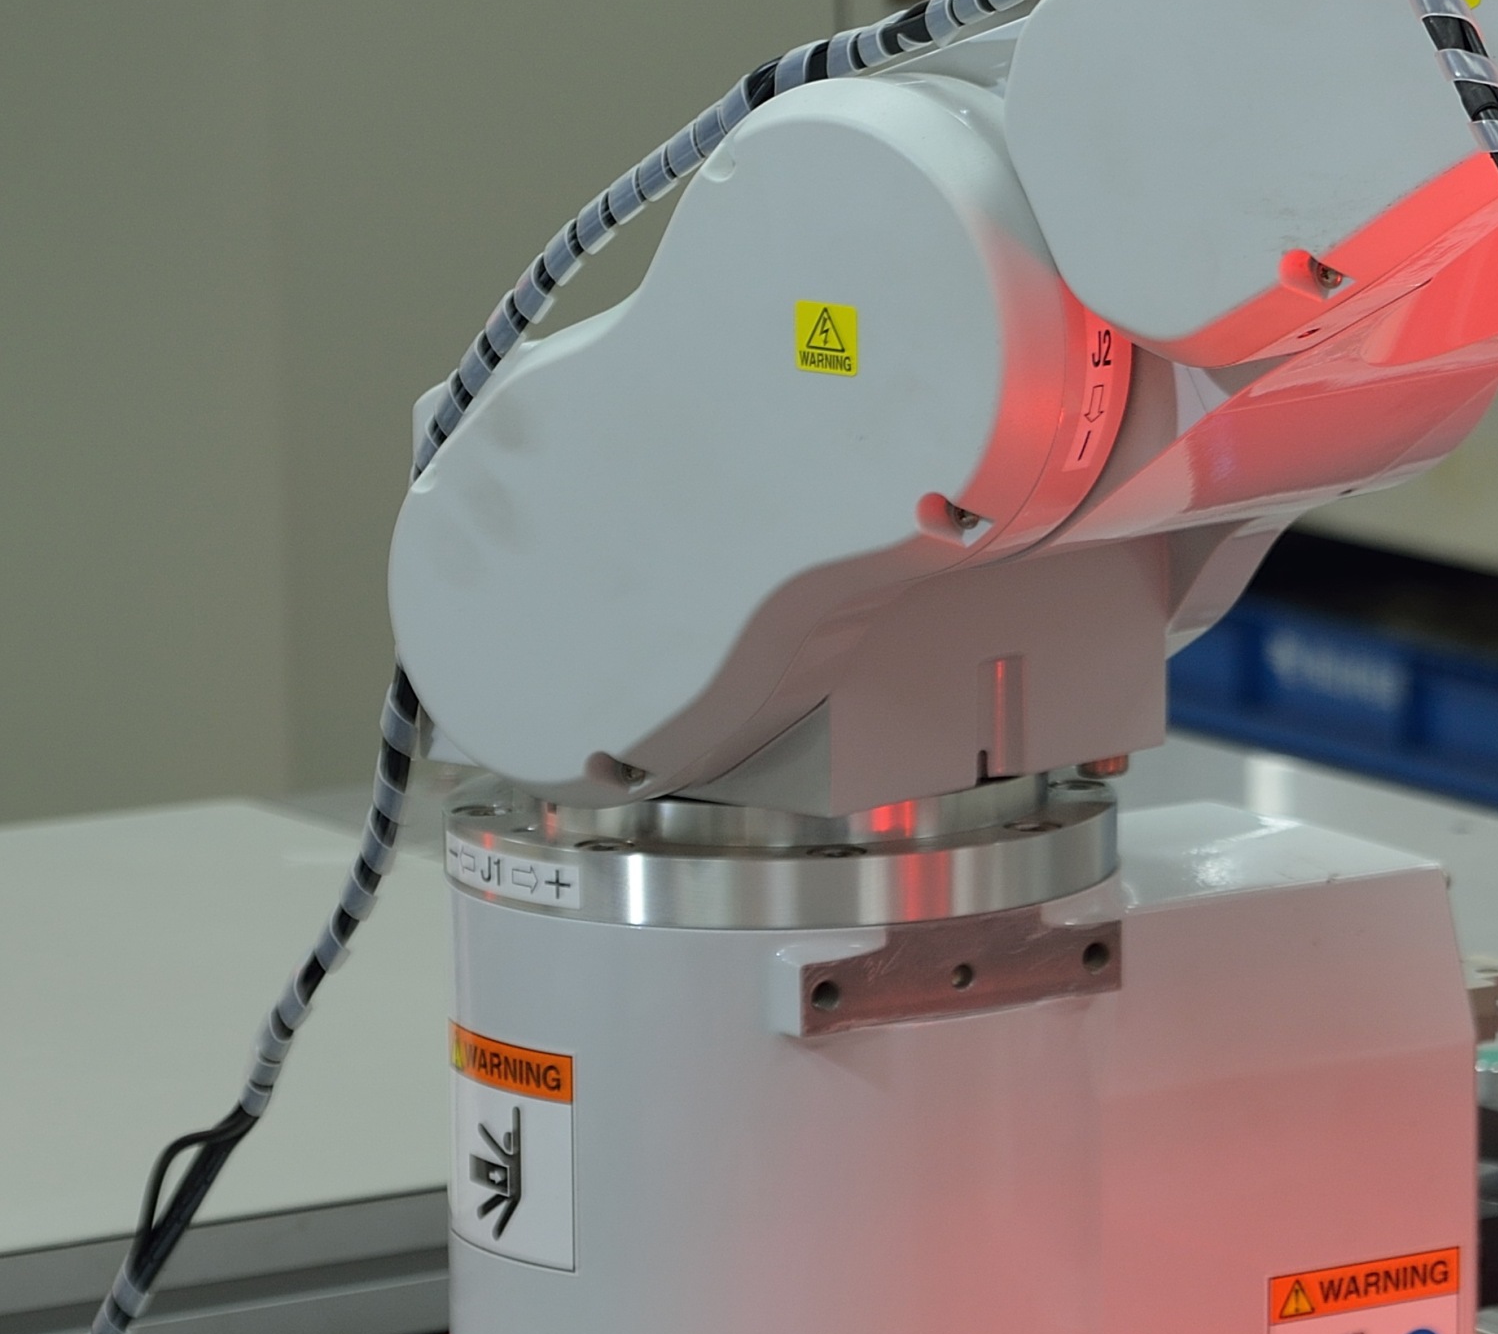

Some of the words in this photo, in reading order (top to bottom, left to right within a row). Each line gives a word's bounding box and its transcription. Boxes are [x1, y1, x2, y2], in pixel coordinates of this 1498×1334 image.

[799, 350, 852, 372] WARNING
[1091, 328, 1112, 368] J2
[479, 857, 502, 887] J1
[465, 1041, 563, 1094] WARNING
[1319, 1260, 1450, 1304] WARNING
